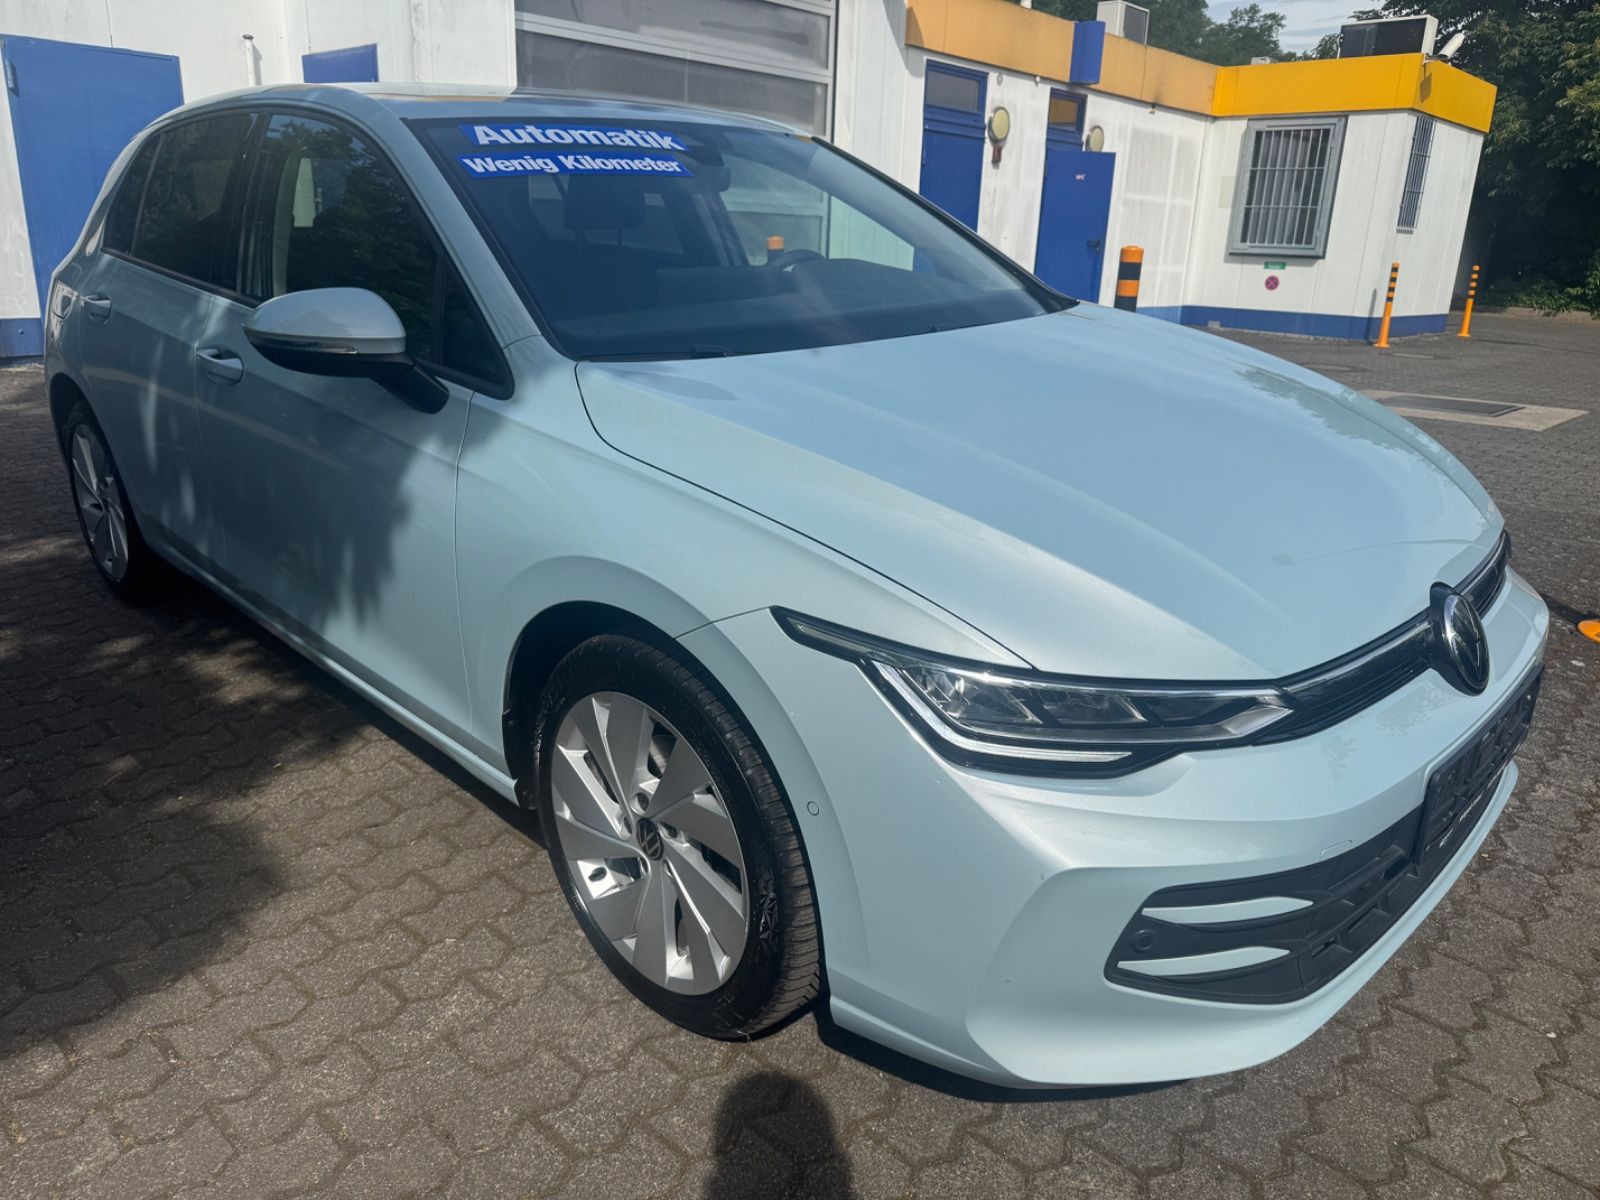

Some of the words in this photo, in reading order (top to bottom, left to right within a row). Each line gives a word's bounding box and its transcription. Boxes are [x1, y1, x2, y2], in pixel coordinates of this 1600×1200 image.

[473, 125, 685, 150] Automatik
[462, 156, 560, 173] Wenig
[557, 155, 683, 173] Kilometer
